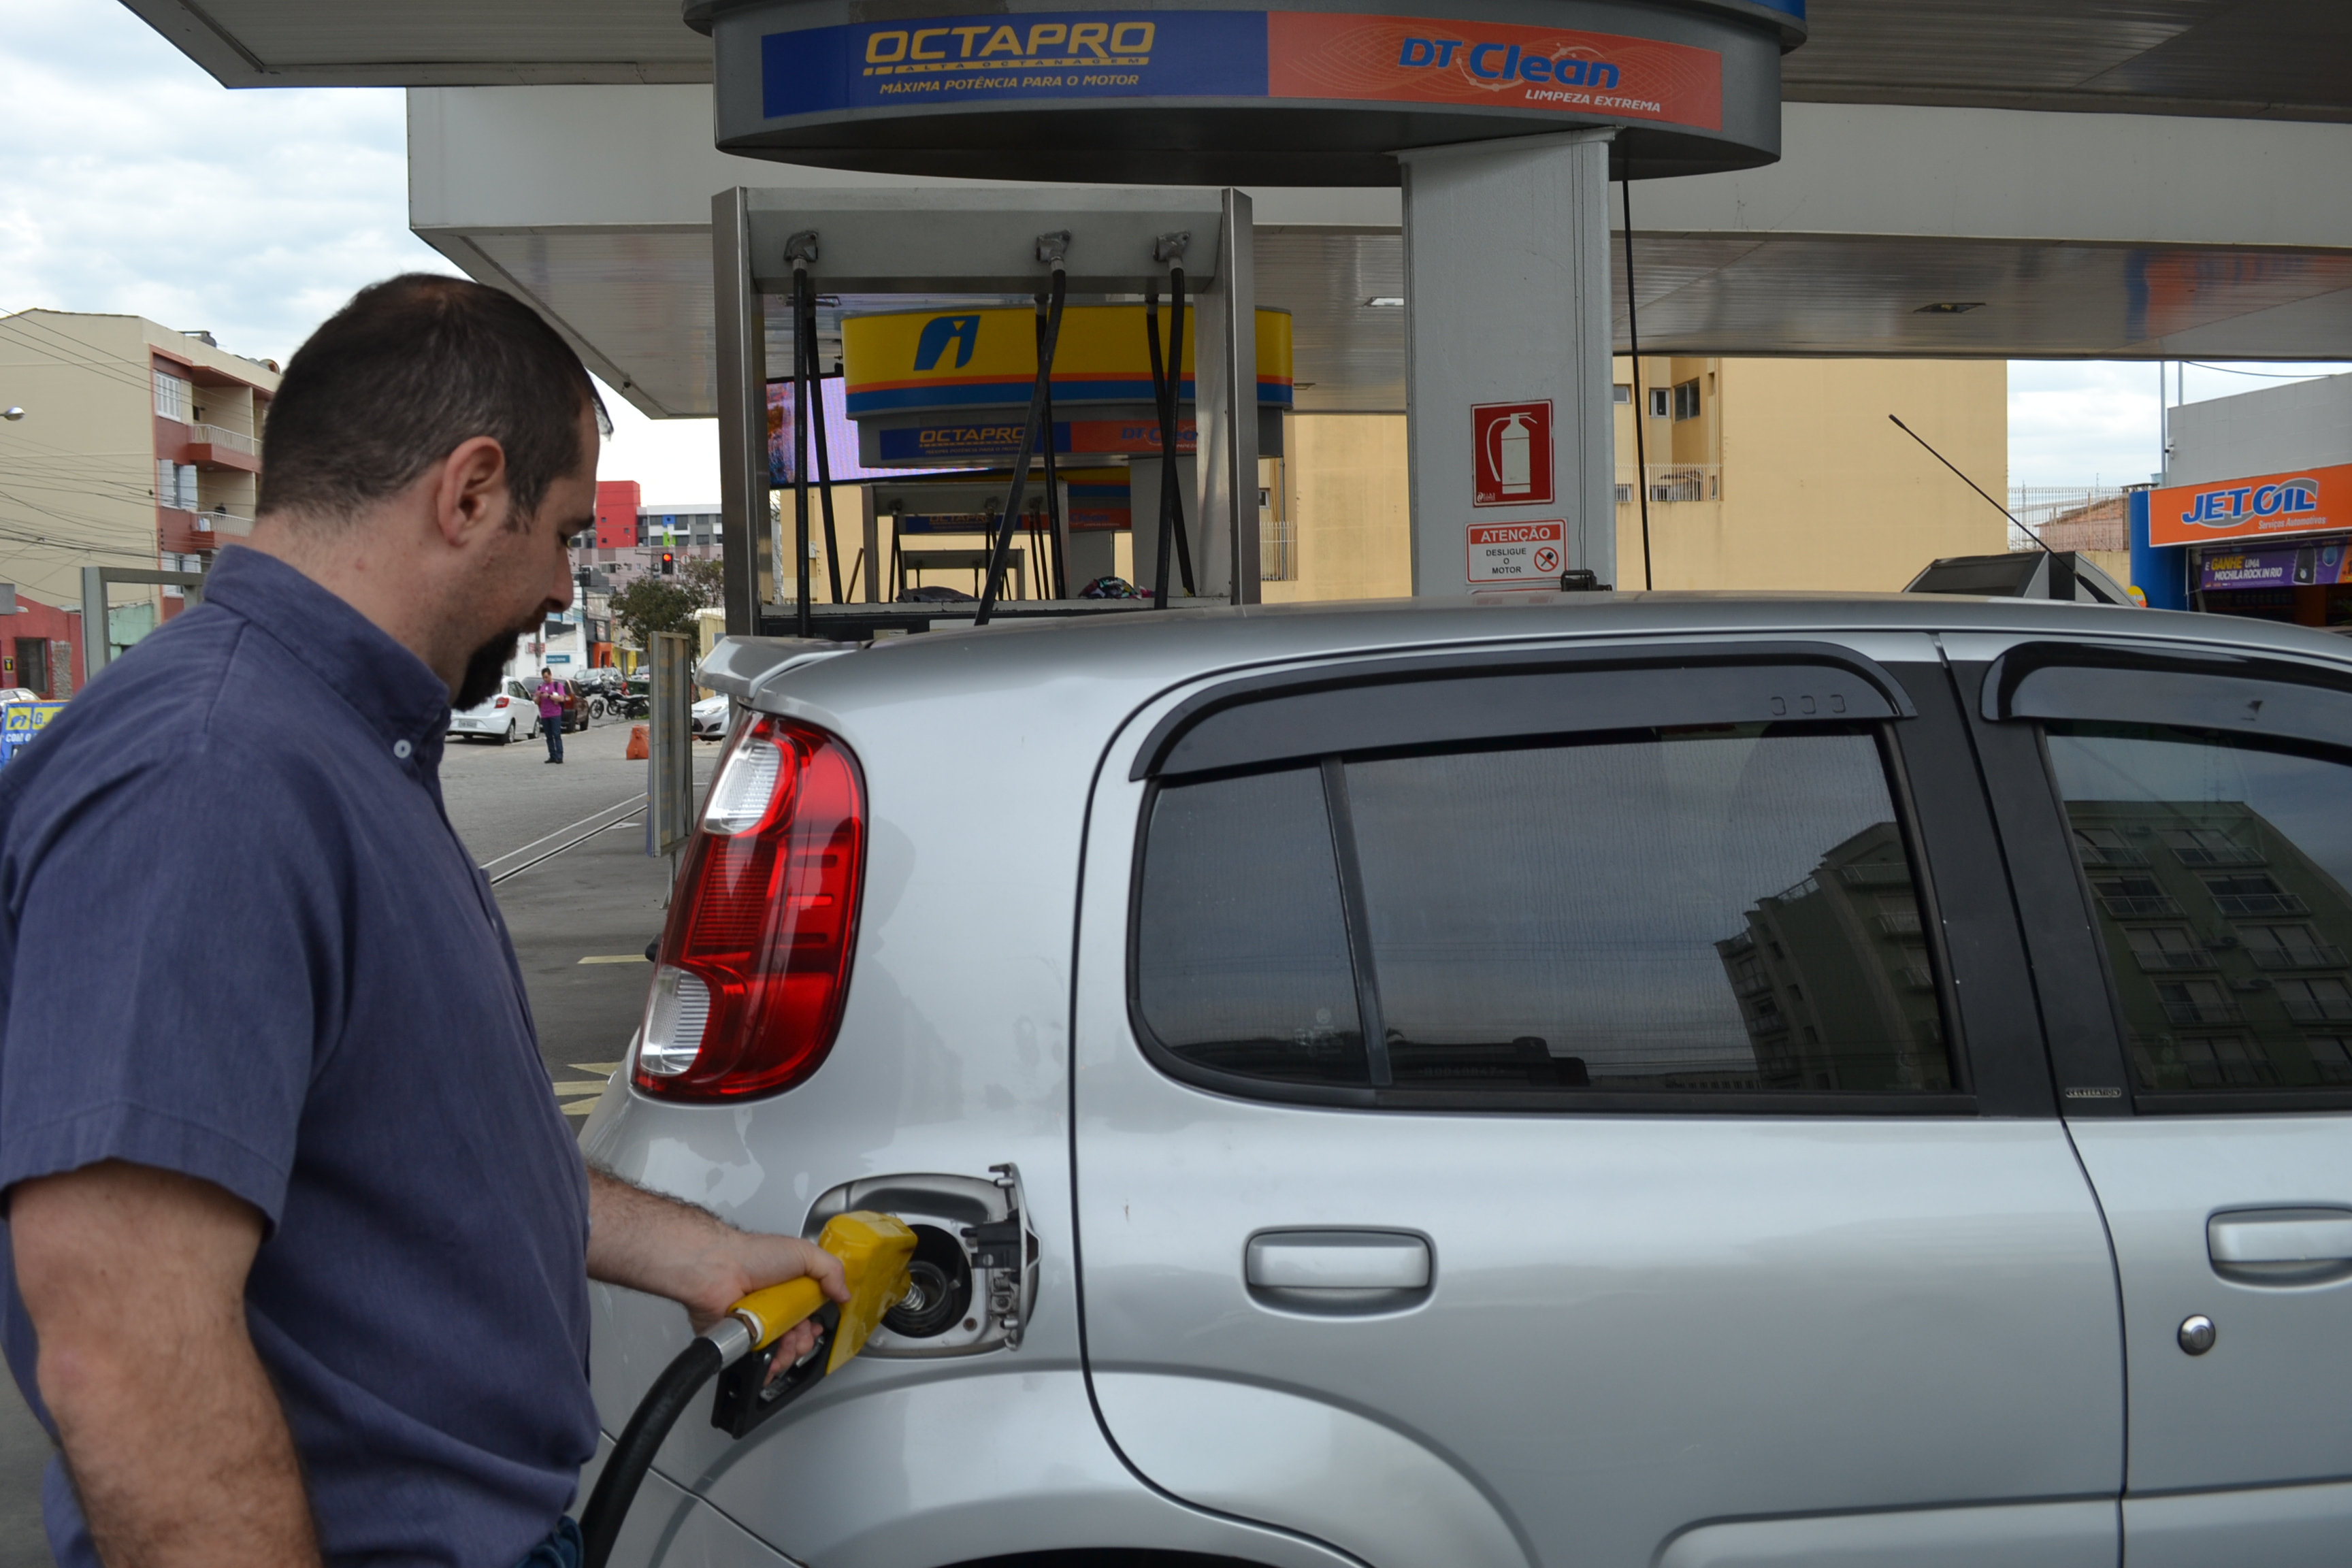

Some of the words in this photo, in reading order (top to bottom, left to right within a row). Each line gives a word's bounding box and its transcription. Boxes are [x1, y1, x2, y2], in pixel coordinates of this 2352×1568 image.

[865, 22, 1156, 63] OCTAPRO
[905, 63, 965, 71] ALTA
[982, 59, 1140, 68] OCTANAGEM
[1398, 37, 1463, 68] DT
[1469, 42, 1620, 89] Clean
[880, 80, 940, 94] MÁXIMA
[944, 76, 1018, 90] POTÊNCIA
[1022, 76, 1062, 88] PARA
[1066, 76, 1079, 86] O
[1082, 74, 1140, 86] MOTOR
[1524, 89, 1590, 105] LIMPEZA
[1593, 95, 1661, 113] EXTREMA
[1122, 427, 1145, 440] DT
[2258, 519, 2285, 530] Serviços
[2285, 514, 2326, 527] Automotivos
[1480, 525, 1551, 542] ATENÇÃO
[1486, 547, 1526, 557] DESLIGUE
[1492, 566, 1522, 574] MOTOR
[2204, 561, 2210, 571] E
[2244, 559, 2259, 568] UMA
[2214, 569, 2243, 581] MOCHILA
[2243, 568, 2263, 580] ROCK
[2261, 568, 2270, 578] IN
[2270, 567, 2283, 578] RIO
[5, 733, 24, 743] COM
